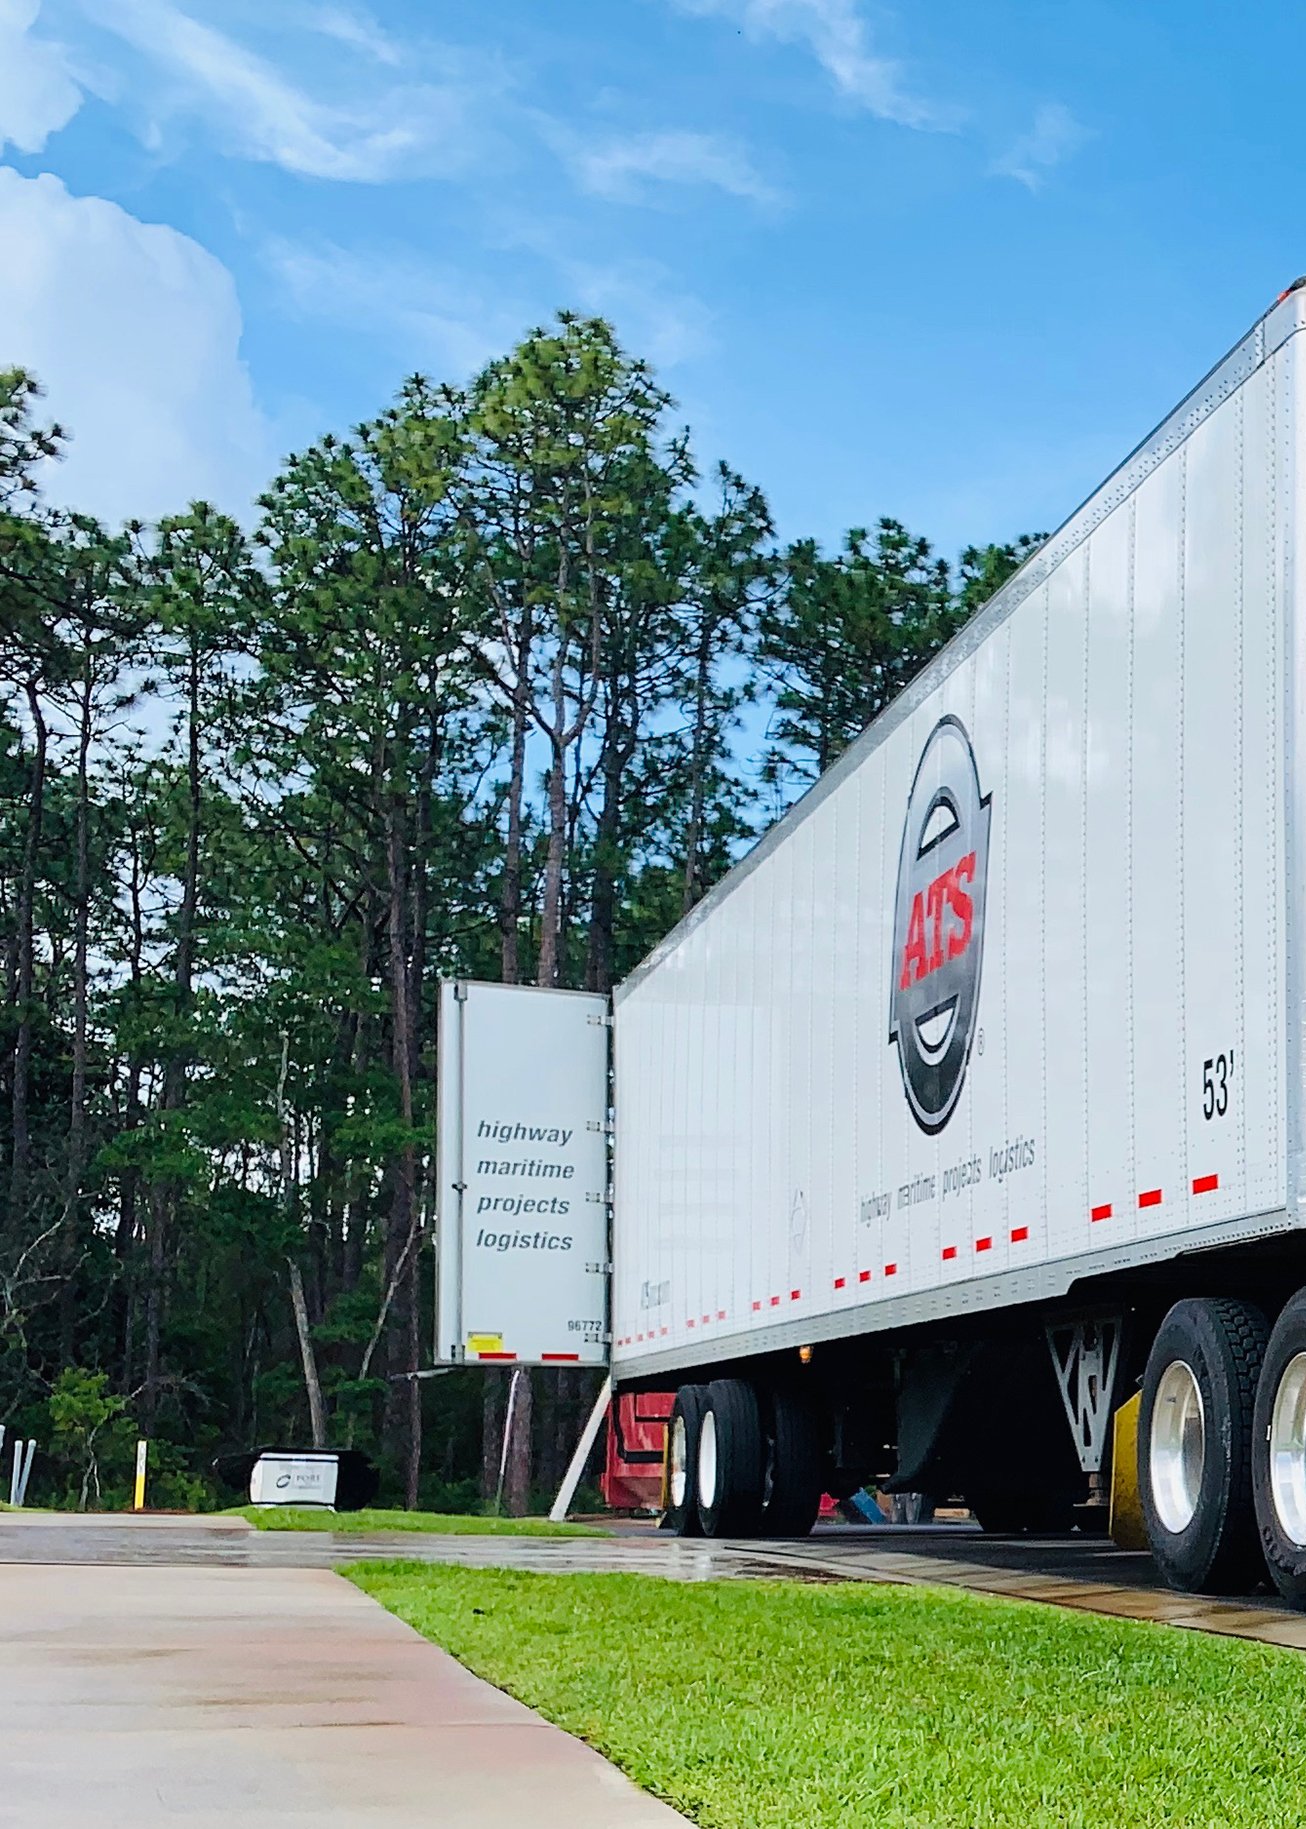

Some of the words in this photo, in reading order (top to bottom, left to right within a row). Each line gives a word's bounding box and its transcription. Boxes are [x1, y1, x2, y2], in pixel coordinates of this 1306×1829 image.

[899, 850, 976, 991] ATS
[1203, 1049, 1234, 1121] 53'
[477, 1119, 573, 1147] highway
[477, 1159, 575, 1179] maritime
[942, 1153, 982, 1202] projects
[988, 1134, 1036, 1184] logistics
[477, 1193, 570, 1216] projects
[476, 1229, 573, 1252] logistics
[567, 1320, 602, 1331] 96772
